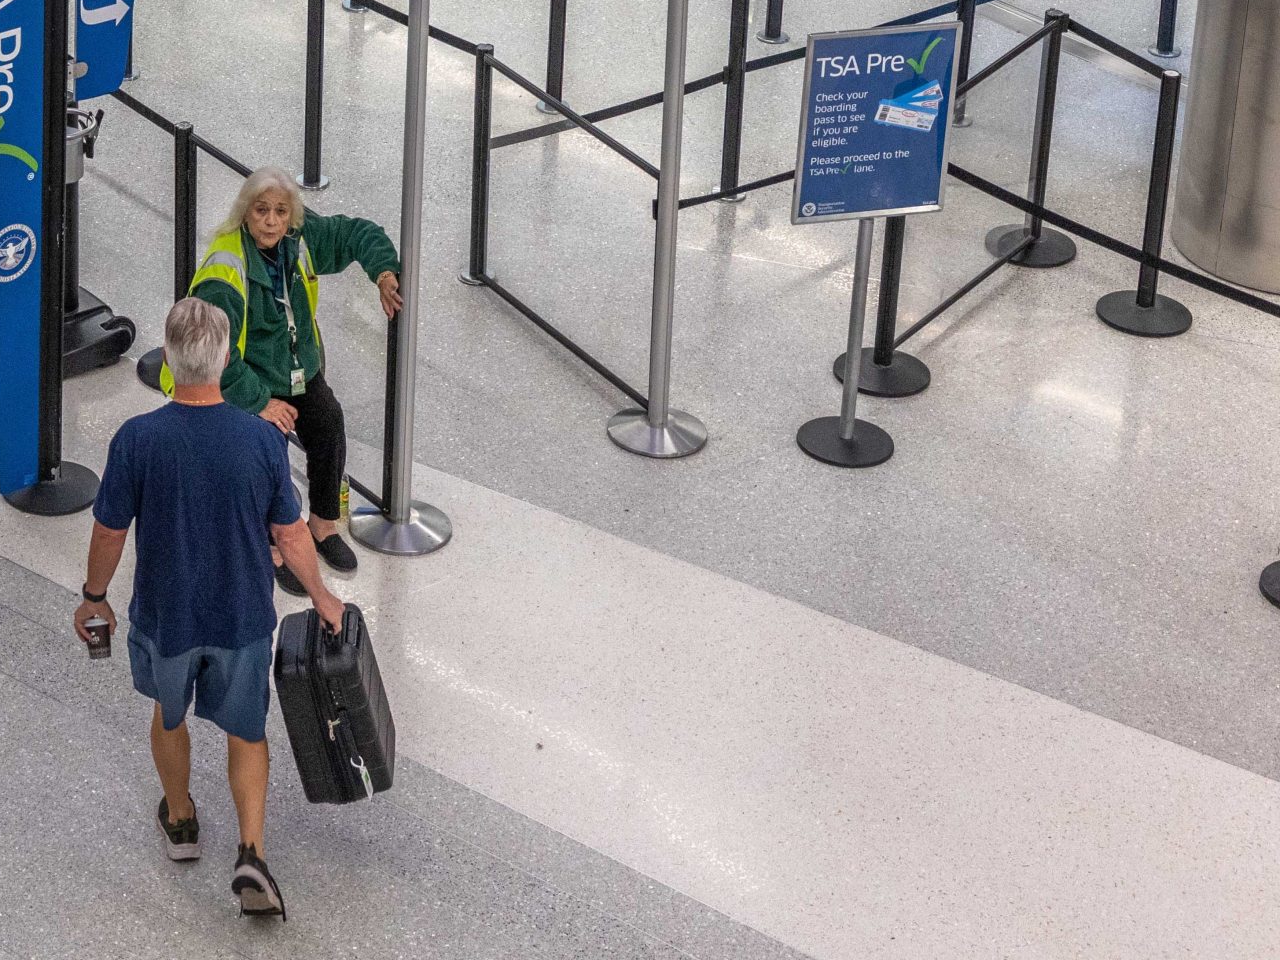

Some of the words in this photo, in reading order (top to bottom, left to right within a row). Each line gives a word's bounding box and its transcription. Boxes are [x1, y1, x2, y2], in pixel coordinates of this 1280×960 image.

[816, 55, 859, 78] TSA
[867, 53, 905, 75] Pre
[816, 91, 844, 102] Check
[846, 90, 868, 101] your
[815, 103, 857, 114] boarding
[813, 116, 835, 125] pass
[813, 127, 820, 136] if
[822, 127, 840, 136] you
[842, 126, 858, 134] are
[811, 137, 848, 148] eligible.
[810, 156, 840, 165] Please
[843, 152, 880, 164] proceed
[882, 151, 892, 159] to
[894, 149, 910, 158] the
[809, 168, 825, 176] TSA
[825, 167, 839, 175] Pre
[853, 164, 875, 173] lane.
